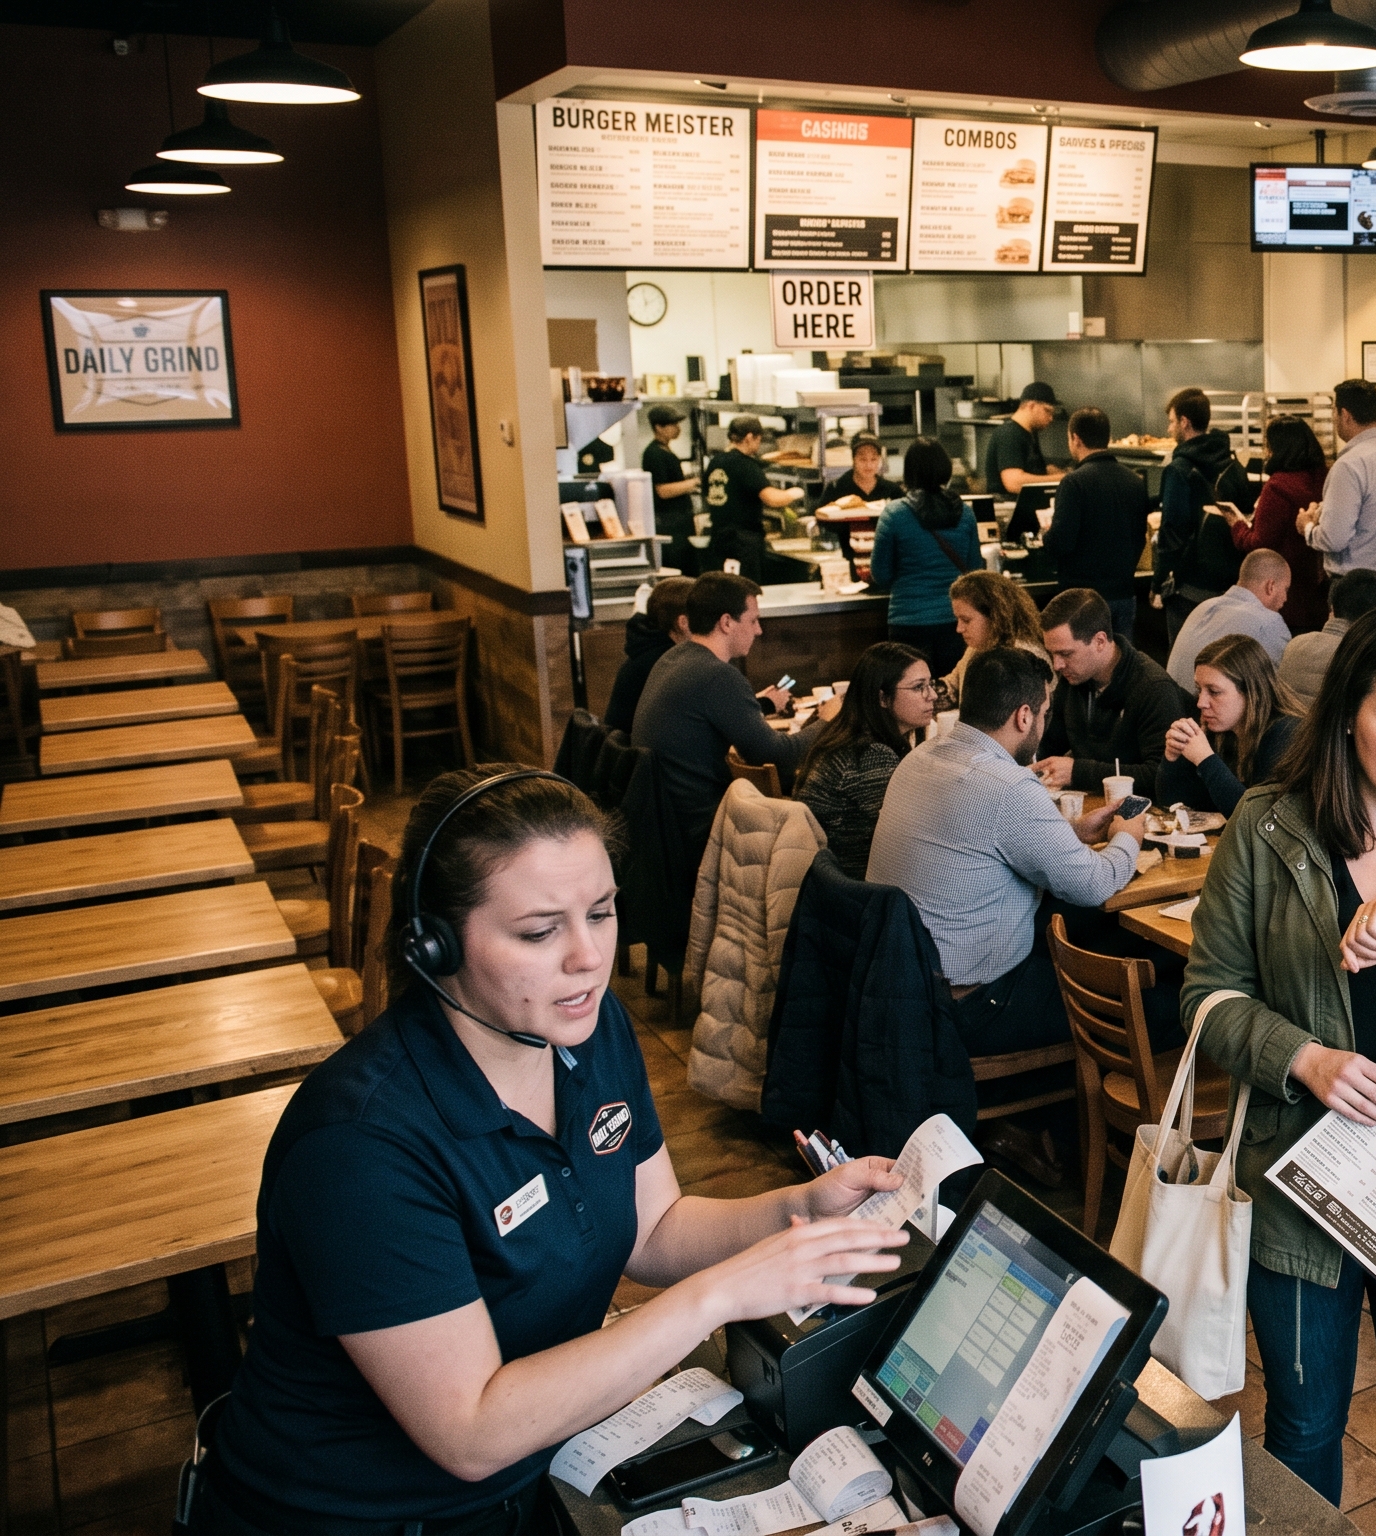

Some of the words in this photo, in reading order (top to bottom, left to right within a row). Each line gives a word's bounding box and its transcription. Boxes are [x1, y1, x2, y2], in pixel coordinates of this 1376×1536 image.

[552, 106, 637, 132] BURGER
[645, 112, 734, 137] MEISTER
[944, 128, 1017, 150] COMBOS
[782, 280, 862, 306] ORDER
[793, 313, 855, 339] HERE
[64, 347, 134, 374] DAILY
[144, 346, 220, 372] GRIND
